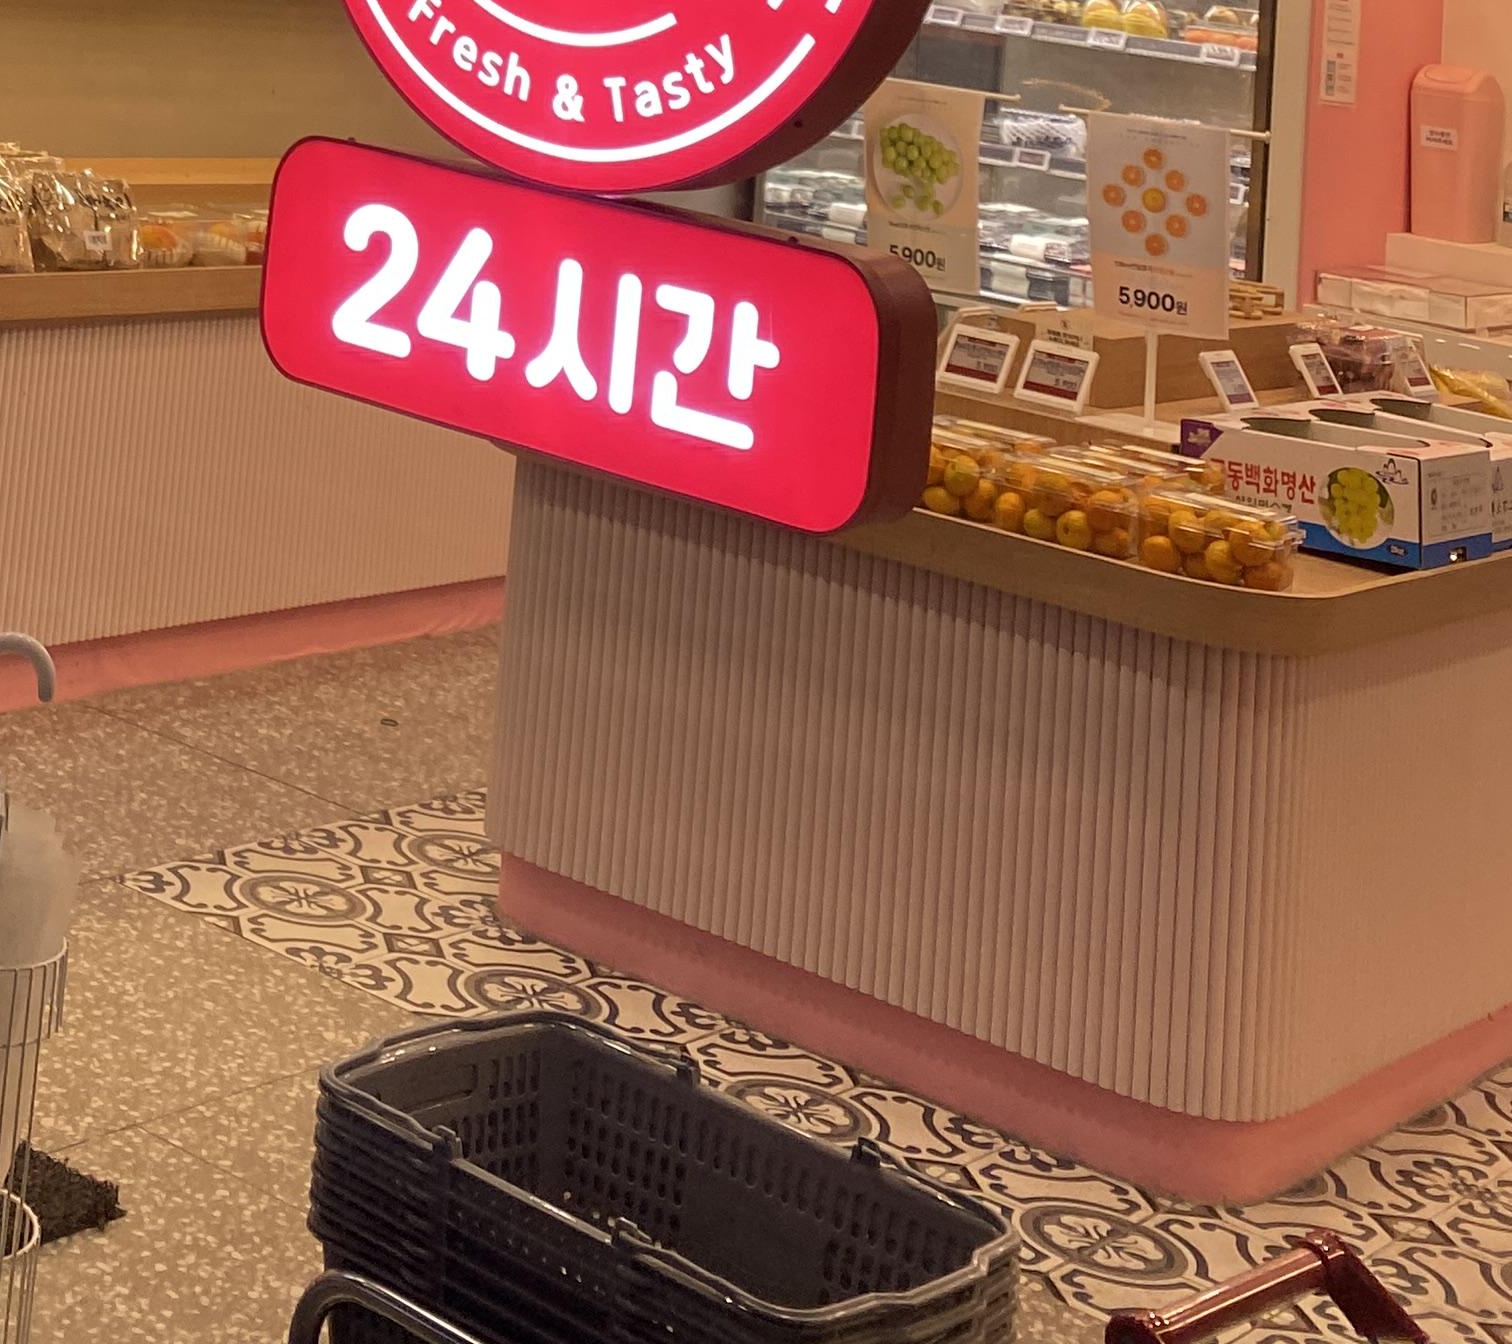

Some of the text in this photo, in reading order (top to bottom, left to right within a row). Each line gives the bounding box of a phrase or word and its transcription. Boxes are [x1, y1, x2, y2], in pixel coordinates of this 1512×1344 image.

[551, 73, 586, 125] &
[608, 28, 739, 124] Tasty
[329, 203, 784, 452] 24시간
[1117, 285, 1188, 316] 5,900원
[1210, 458, 1317, 505] 동백화명산
